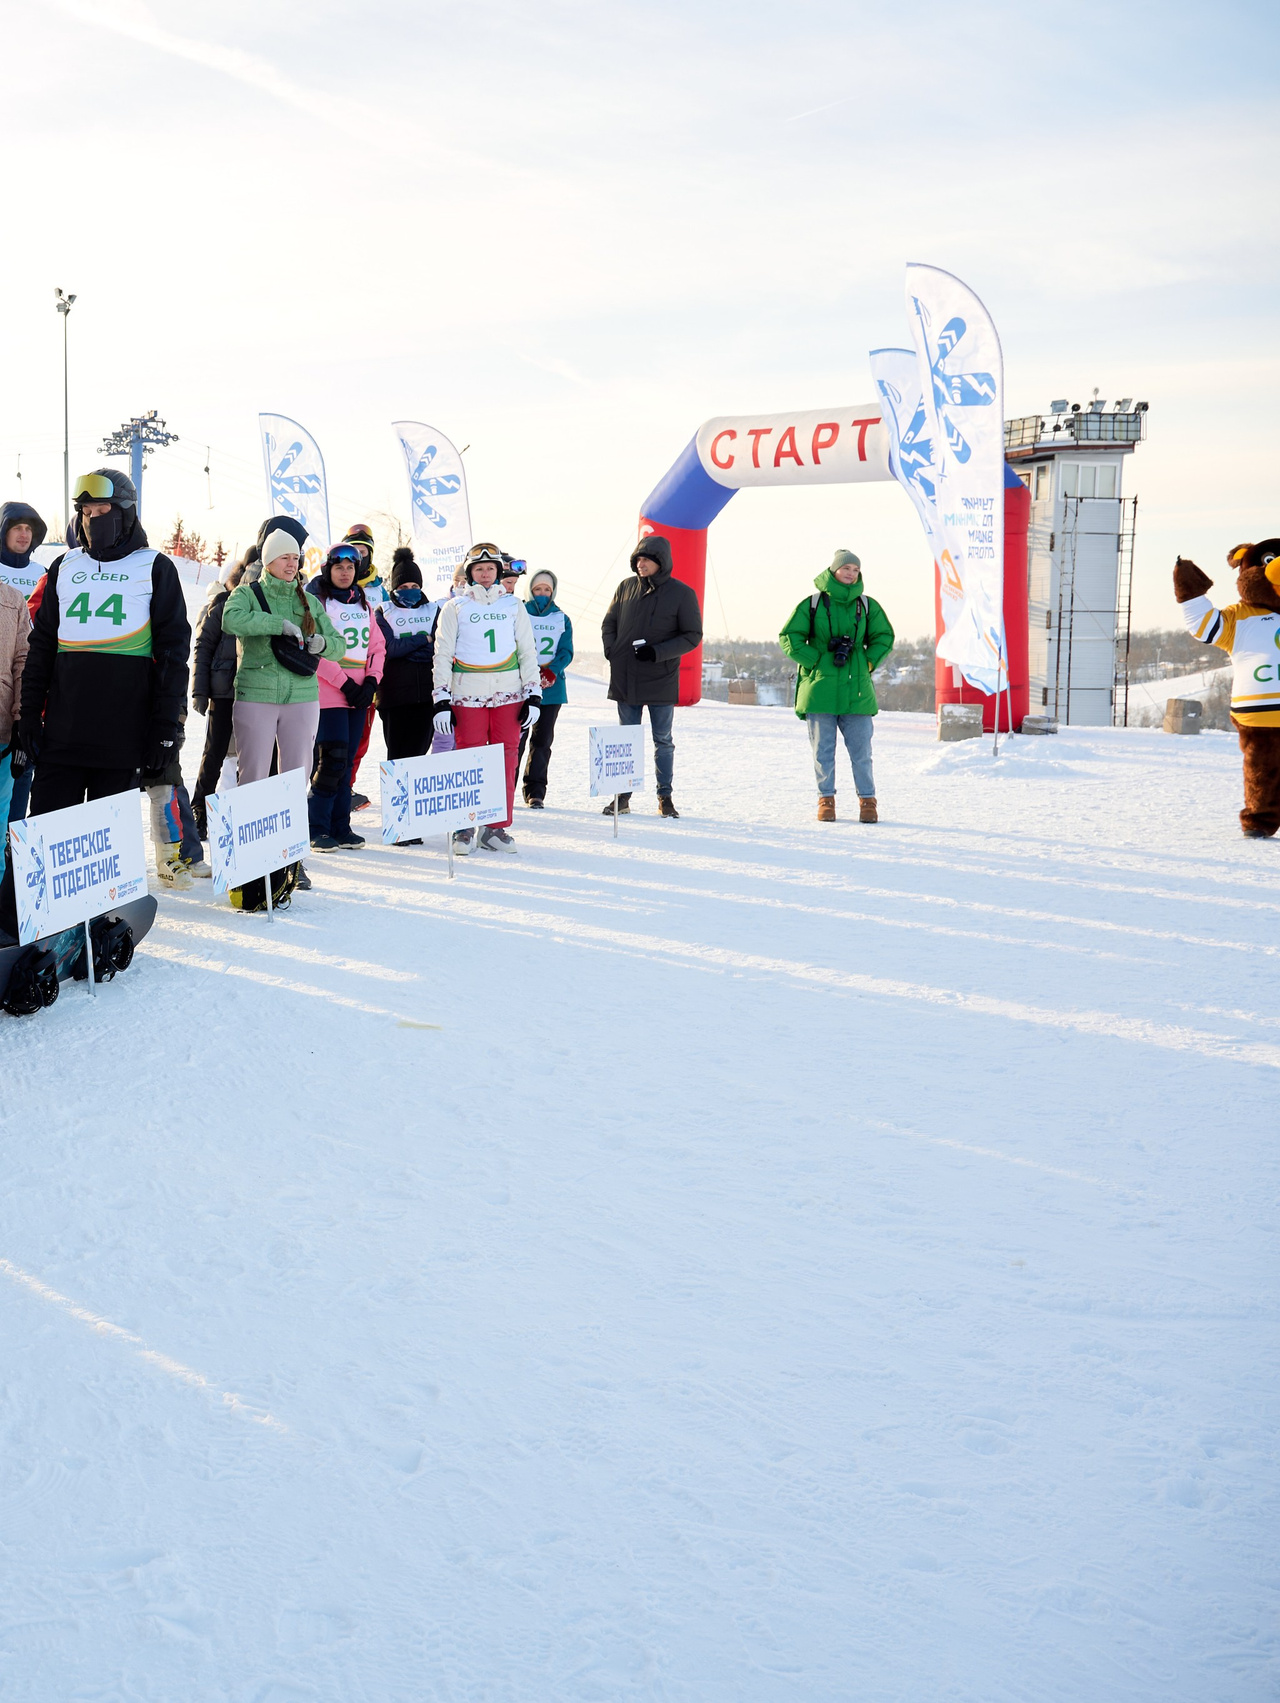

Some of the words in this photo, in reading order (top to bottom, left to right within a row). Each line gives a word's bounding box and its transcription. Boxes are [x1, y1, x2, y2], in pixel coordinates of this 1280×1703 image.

[711, 417, 882, 470] СТАРТ
[90, 572, 130, 583] СБЕР
[65, 592, 128, 626] 44
[408, 616, 431, 625] СБЕР
[483, 613, 508, 621] СБЕР
[483, 628, 496, 653] 1
[413, 767, 485, 796] КАЛУЖСКОЕ
[414, 788, 481, 817] ОТДЕЛЕНИЕ
[238, 813, 278, 846] АППАРАТ
[279, 808, 291, 830] ТБ
[49, 827, 112, 869] ТВЕРСКОЕ
[52, 853, 121, 900] ОТДЕЛЕНИЕ
